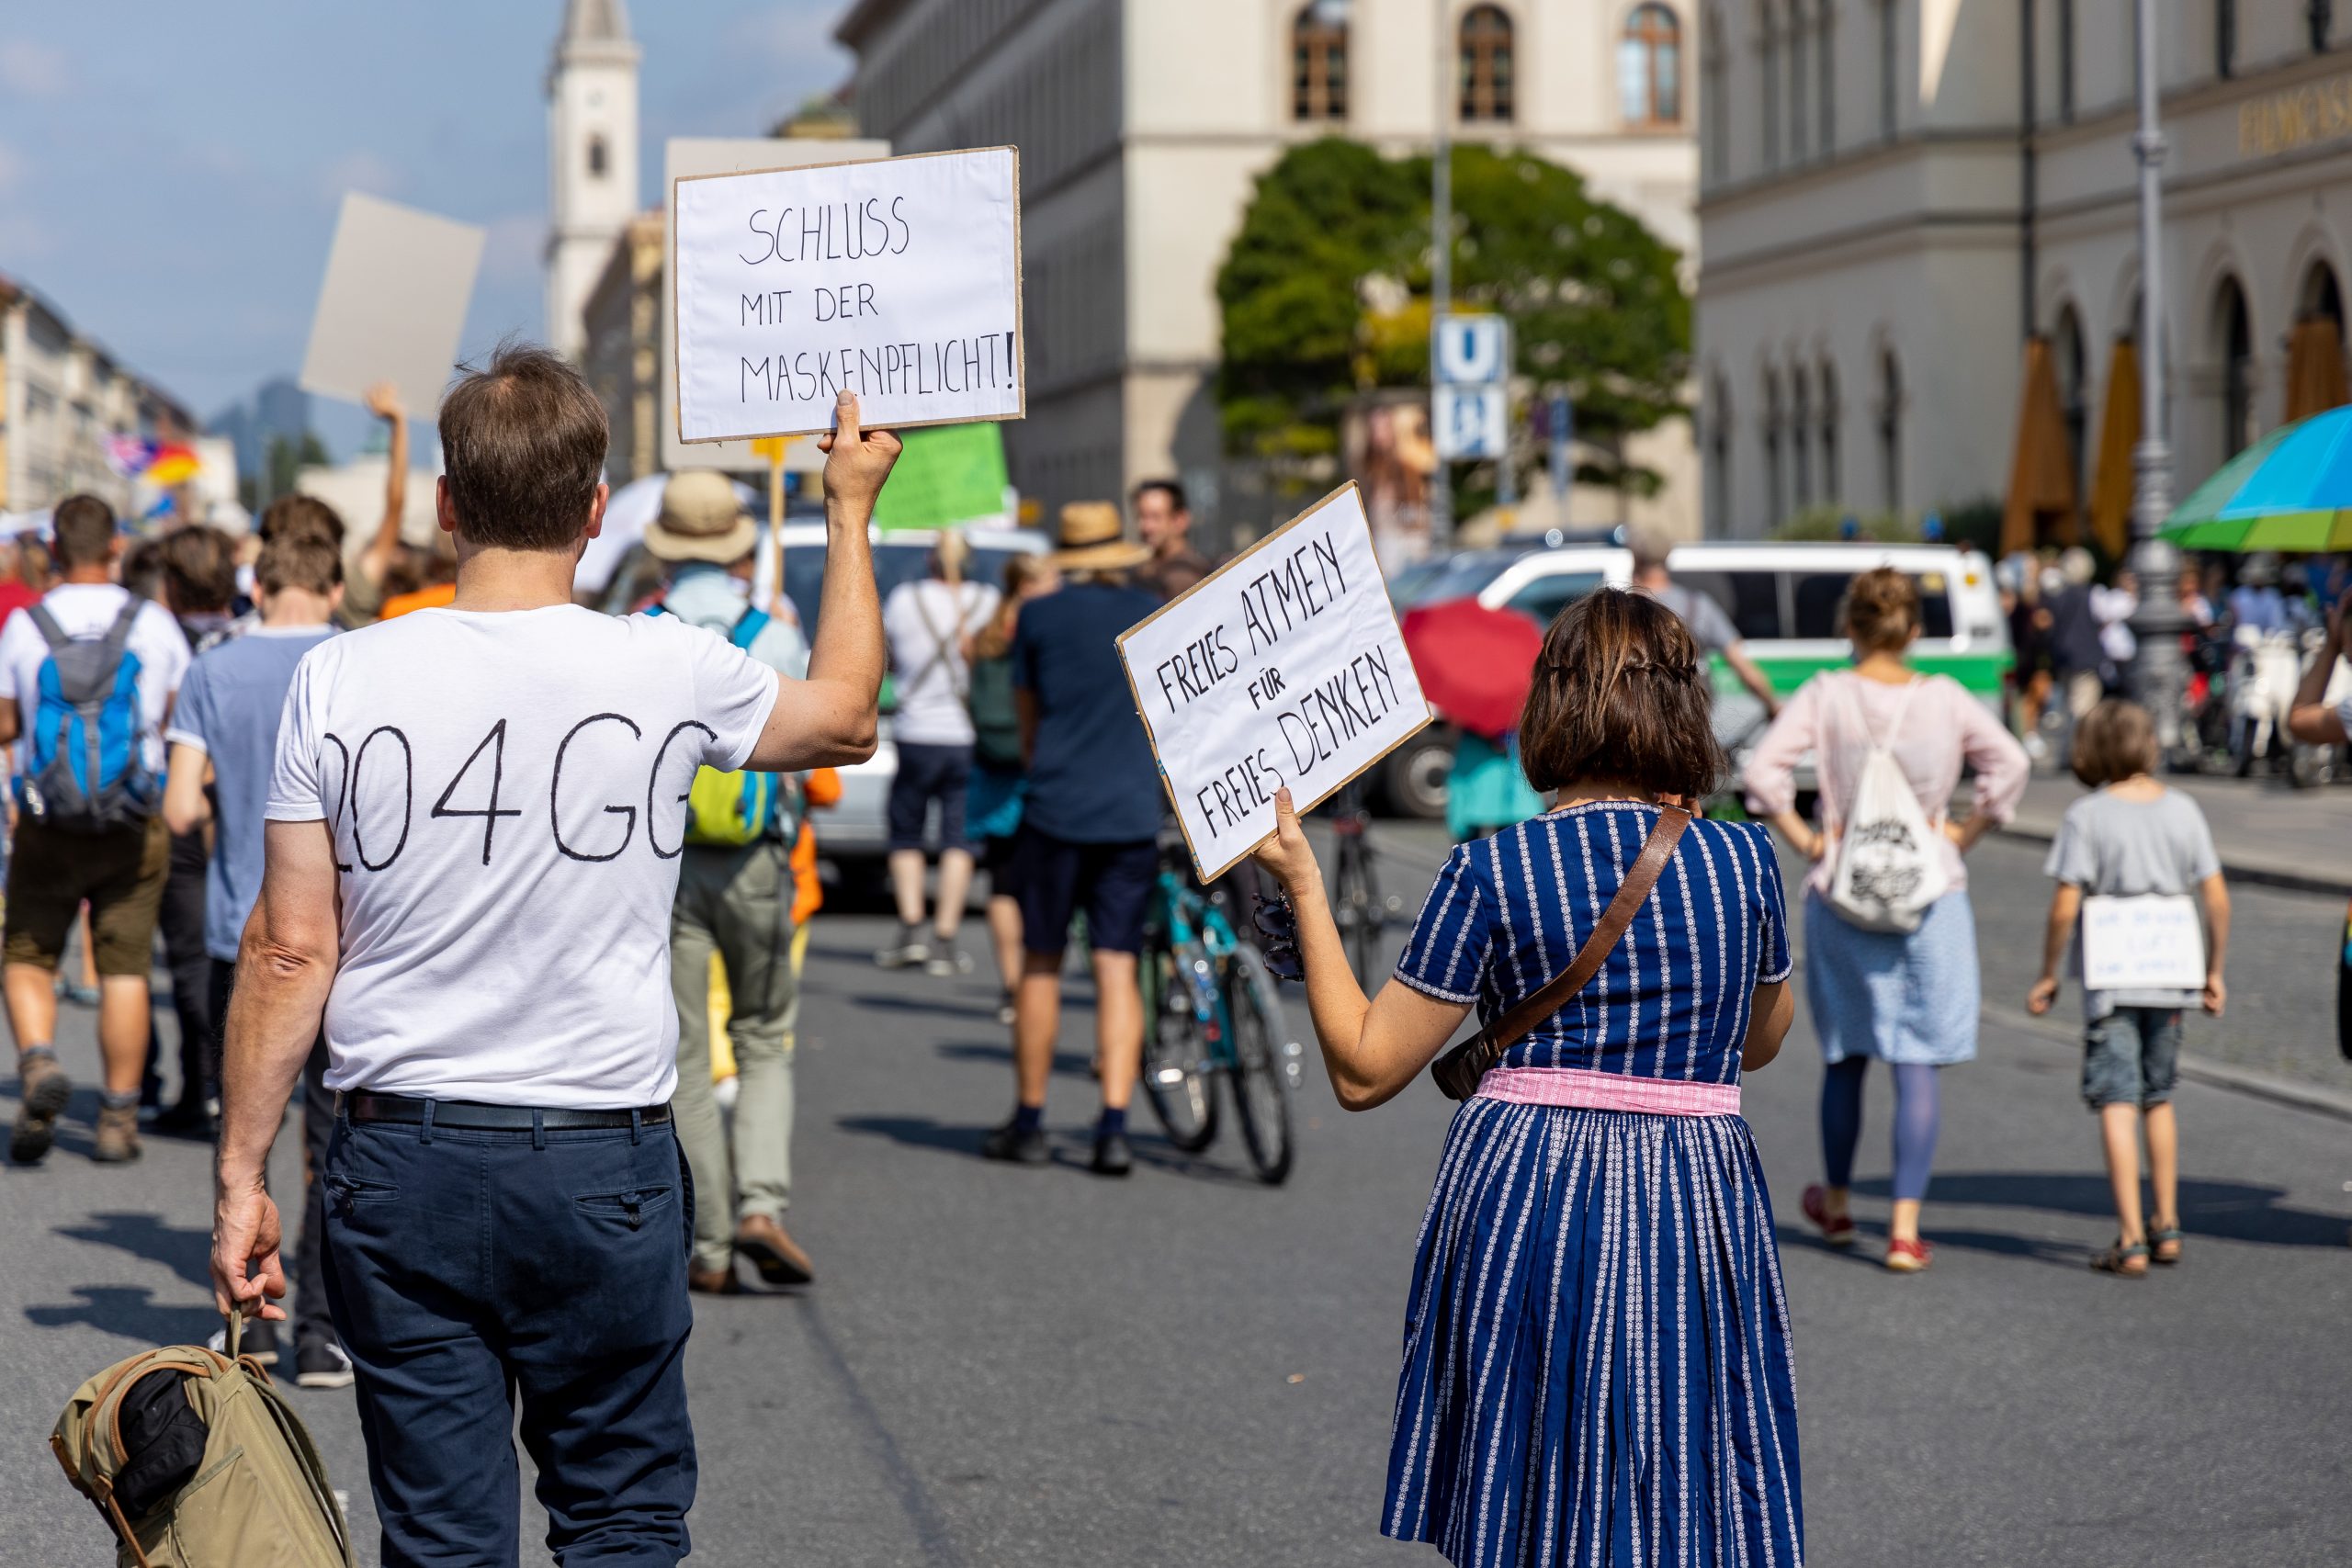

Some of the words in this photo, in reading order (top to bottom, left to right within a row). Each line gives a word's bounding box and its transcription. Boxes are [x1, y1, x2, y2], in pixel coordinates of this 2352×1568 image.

[739, 196, 910, 265] SCHLUSS
[741, 290, 792, 326] MIT
[814, 283, 878, 321] DER
[741, 331, 1014, 403] MASKENPFLICHT!
[1441, 321, 1497, 383] U
[1156, 624, 1238, 715] FREIES
[1240, 531, 1347, 656] ATMEN
[1247, 667, 1286, 711] FÜR
[1196, 748, 1284, 839] FREIES
[1276, 645, 1399, 776] DENKEN
[430, 718, 523, 866] 4
